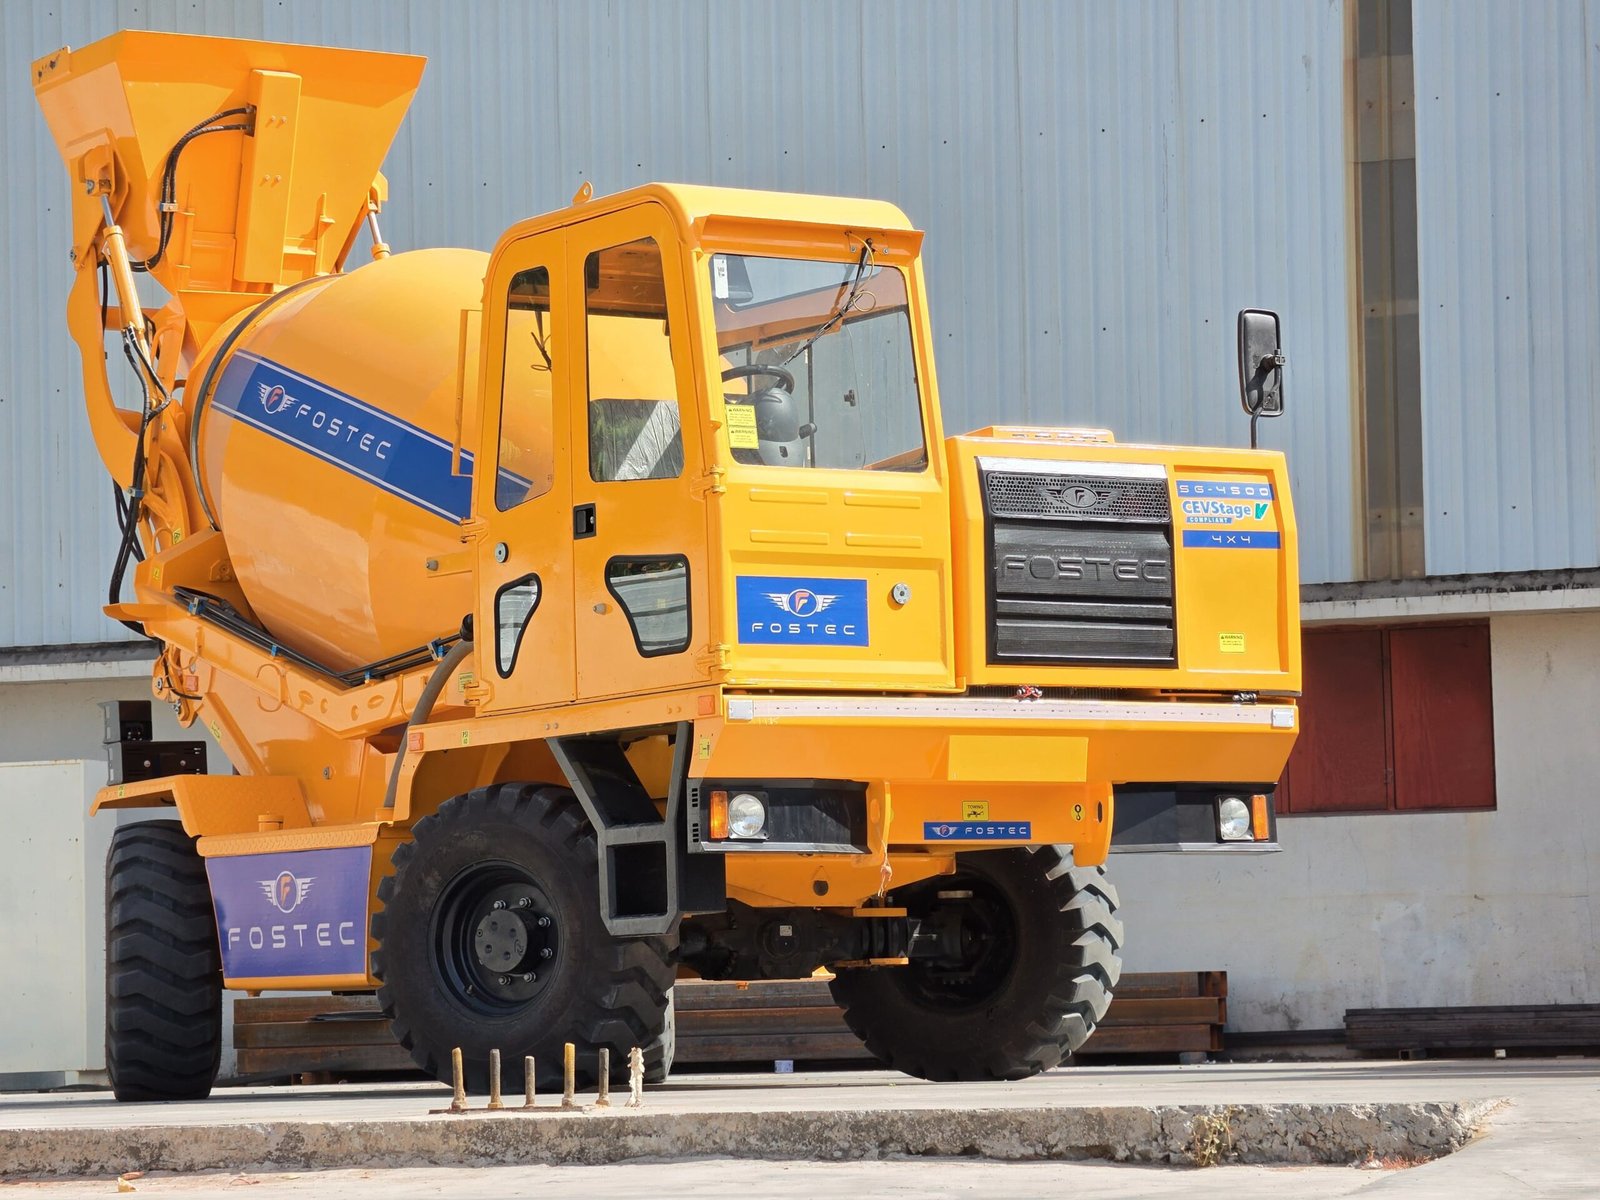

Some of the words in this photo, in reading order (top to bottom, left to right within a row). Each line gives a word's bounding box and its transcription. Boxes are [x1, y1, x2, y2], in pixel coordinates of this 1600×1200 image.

[295, 403, 392, 460] FOSTEC
[1179, 485, 1269, 496] SG-4500
[1182, 500, 1251, 518] CEVStage
[1001, 554, 1167, 583] FOSTEC
[751, 623, 855, 635] FOSTEC
[965, 827, 1027, 835] FOSTEC
[228, 921, 355, 950] FOSTEC
